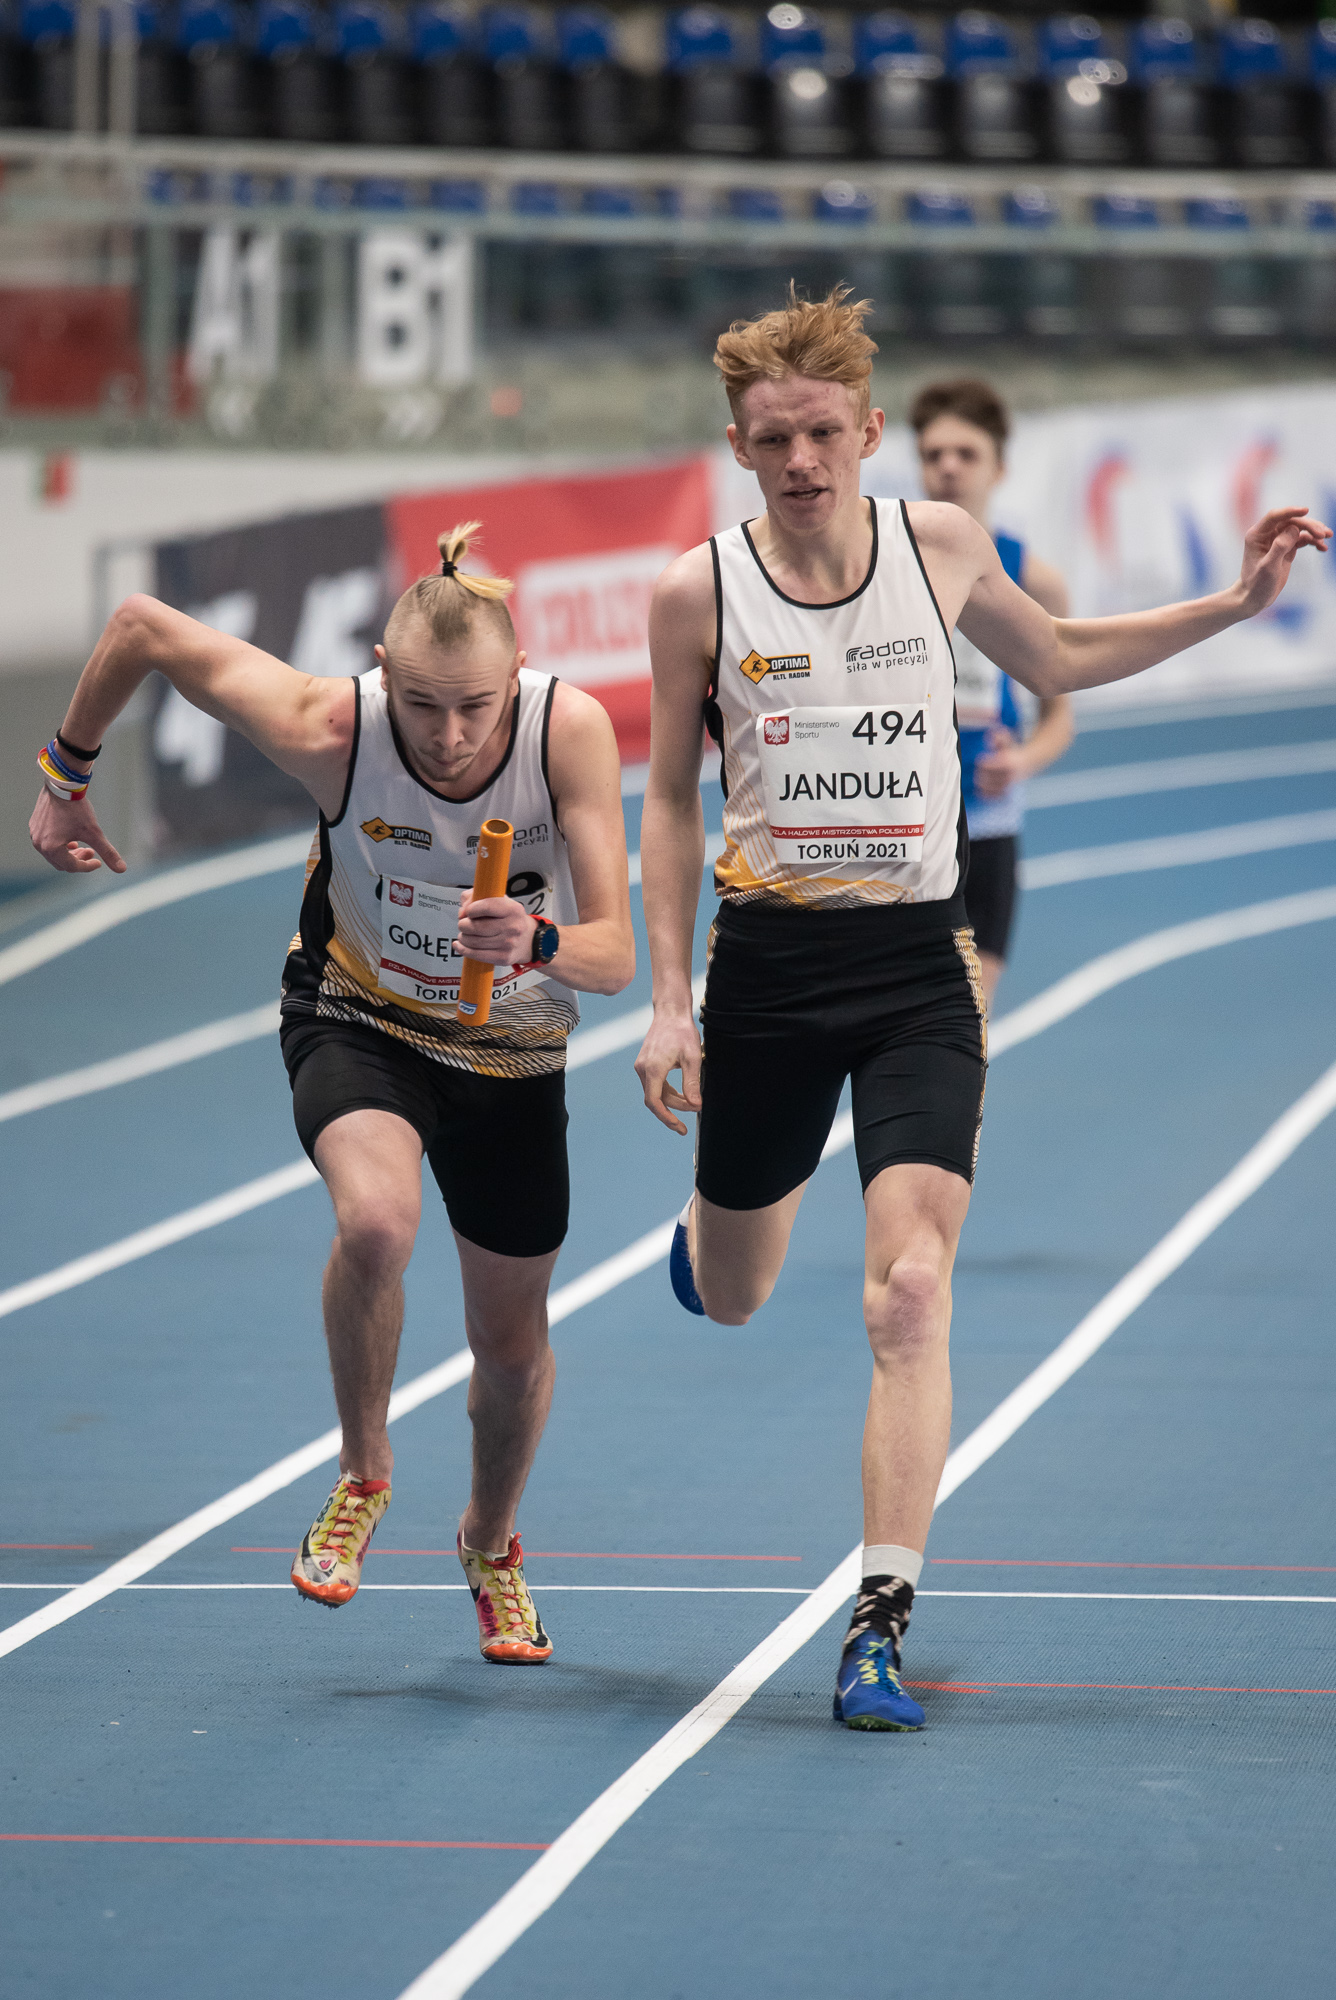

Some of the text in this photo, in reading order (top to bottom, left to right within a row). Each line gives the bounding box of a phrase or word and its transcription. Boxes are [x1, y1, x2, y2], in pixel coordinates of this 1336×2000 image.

[357, 228, 474, 388] B1
[770, 656, 810, 671] OPTIMA
[846, 652, 929, 673] siła w precyzji
[789, 671, 811, 680] RADOM
[794, 720, 840, 729] Ministerstwo
[852, 709, 927, 746] 494
[794, 731, 820, 739] Sportu
[778, 770, 923, 801] JANDUŁA
[394, 828, 430, 844] OPTIMA
[821, 828, 878, 836] MISTRZOSTWA
[797, 839, 907, 860] TORUŃ 2021
[415, 984, 460, 1001] TORU
